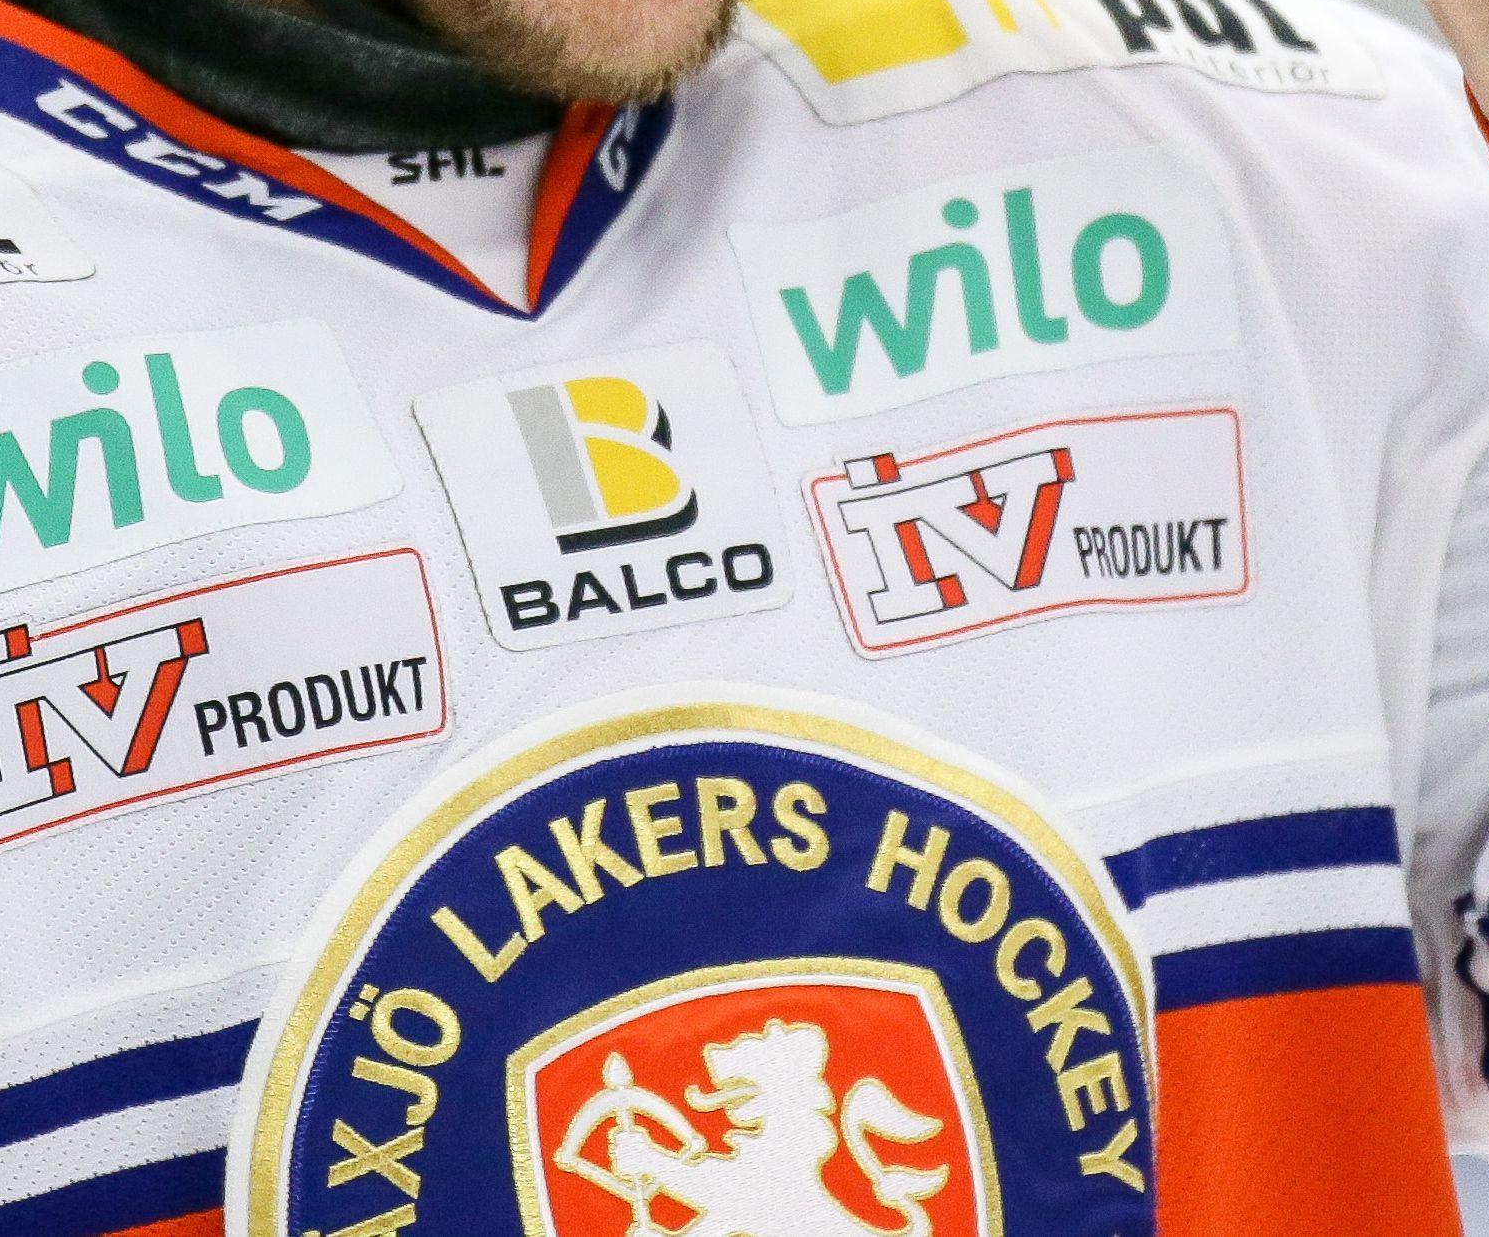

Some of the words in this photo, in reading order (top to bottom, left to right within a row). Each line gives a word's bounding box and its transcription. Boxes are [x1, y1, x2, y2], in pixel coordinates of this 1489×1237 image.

[34, 79, 324, 223] CCM
[780, 188, 1170, 397] wilo
[500, 541, 774, 631] BALCO
[1074, 518, 1229, 580] PRODUKT
[195, 656, 427, 756] PRODUKT
[432, 776, 830, 984] LAKERS
[865, 808, 1144, 1193] HOCKEY
